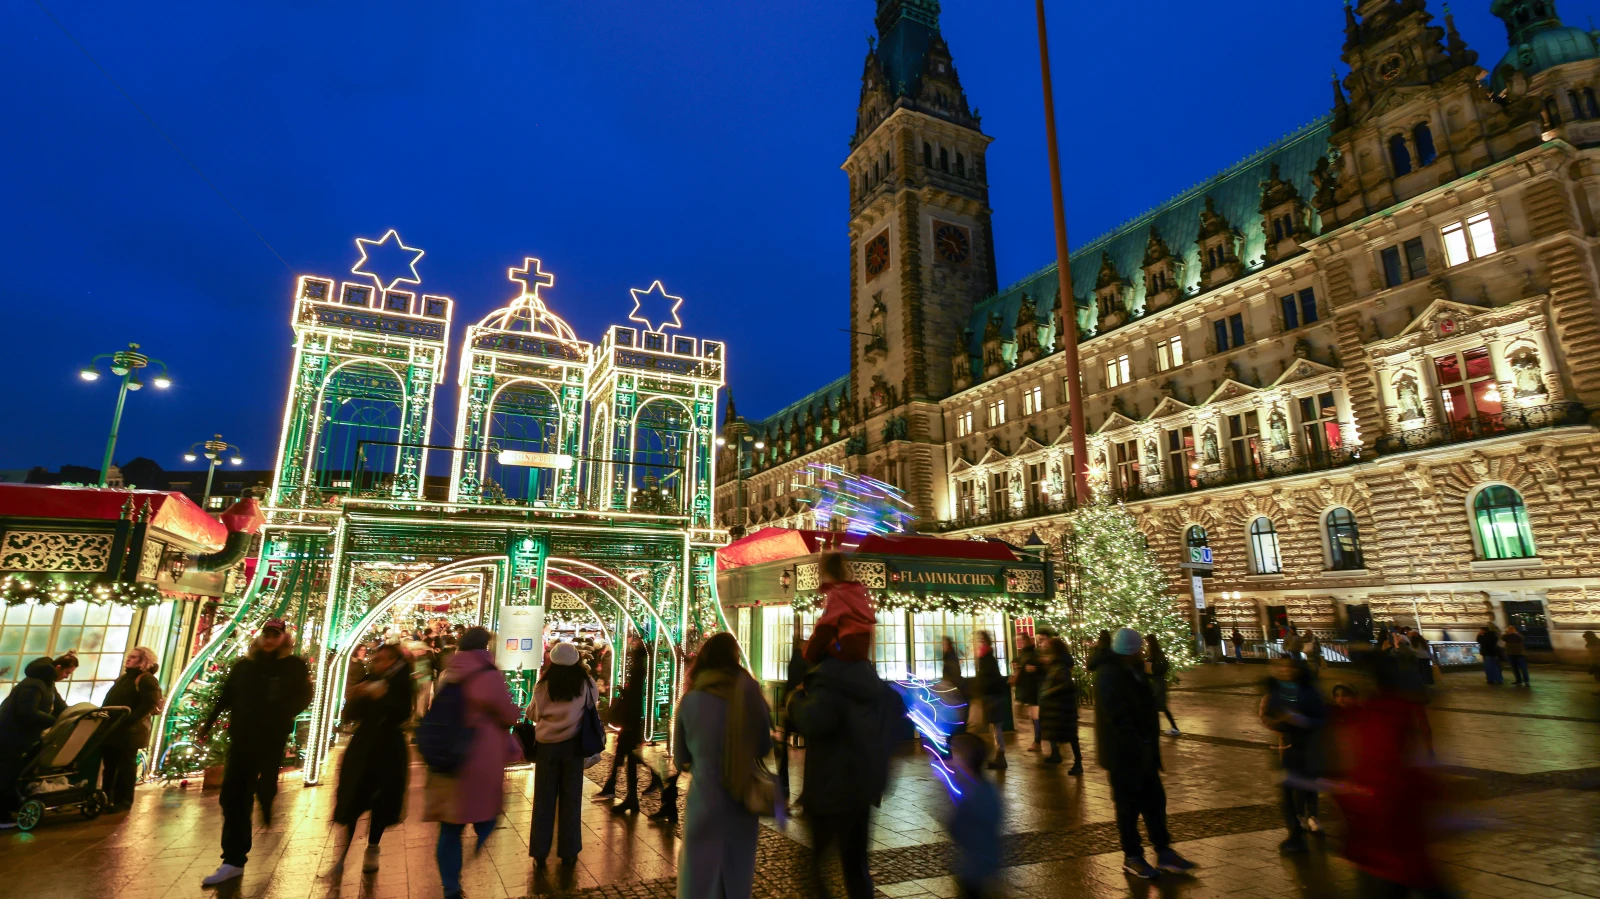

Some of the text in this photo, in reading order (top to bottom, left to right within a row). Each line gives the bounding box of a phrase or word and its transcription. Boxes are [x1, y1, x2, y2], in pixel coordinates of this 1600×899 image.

[1191, 547, 1212, 562] S U
[900, 571, 995, 585] FLAMMKUCHEN
